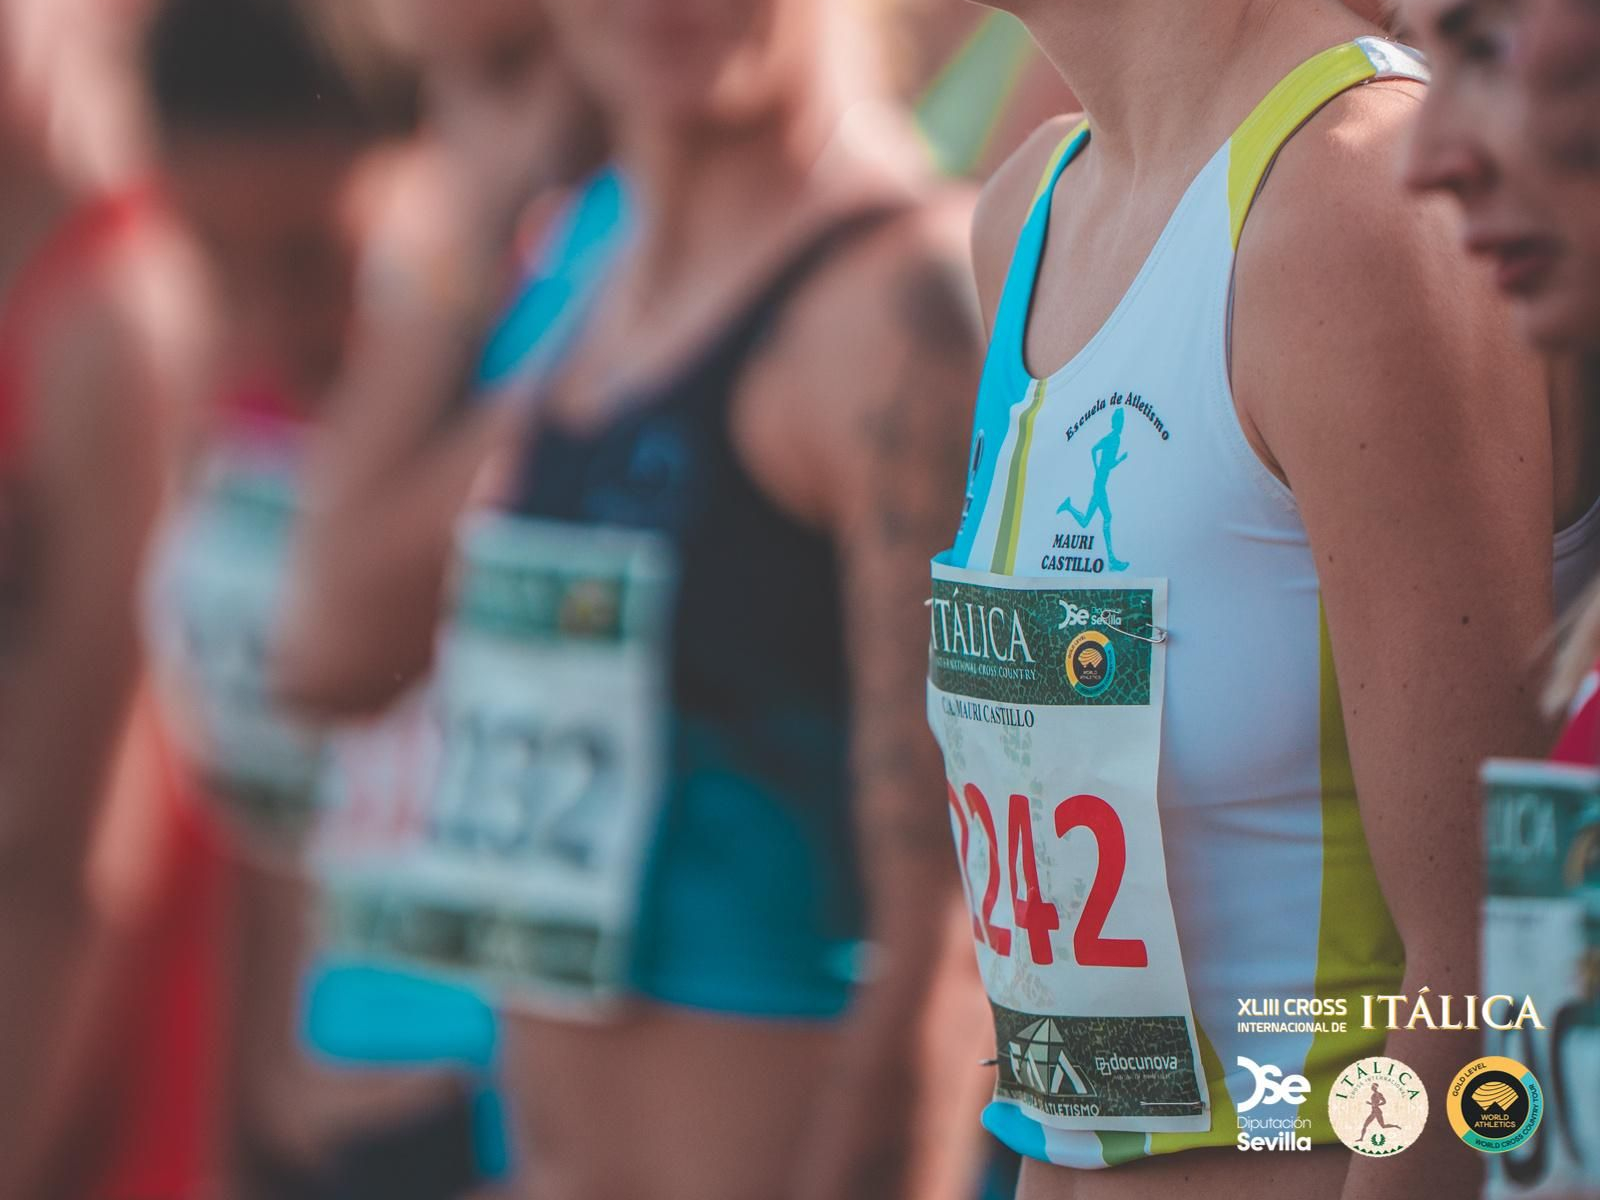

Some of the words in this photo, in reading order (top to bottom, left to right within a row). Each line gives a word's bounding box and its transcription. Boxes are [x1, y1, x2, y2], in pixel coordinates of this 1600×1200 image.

[1065, 399, 1106, 441] Escuela
[1109, 392, 1123, 406] de
[1125, 392, 1169, 440] Atletismo
[1052, 534, 1095, 550] MAURI
[1041, 555, 1104, 573] CASTILLO
[979, 663, 998, 677] CROSS
[998, 666, 1037, 681] COUNTRY
[955, 699, 982, 721] MAURI
[983, 704, 1035, 728] CASTILLO
[1109, 1053, 1178, 1070] docunova
[1044, 1101, 1099, 1117] ATLETISMO
